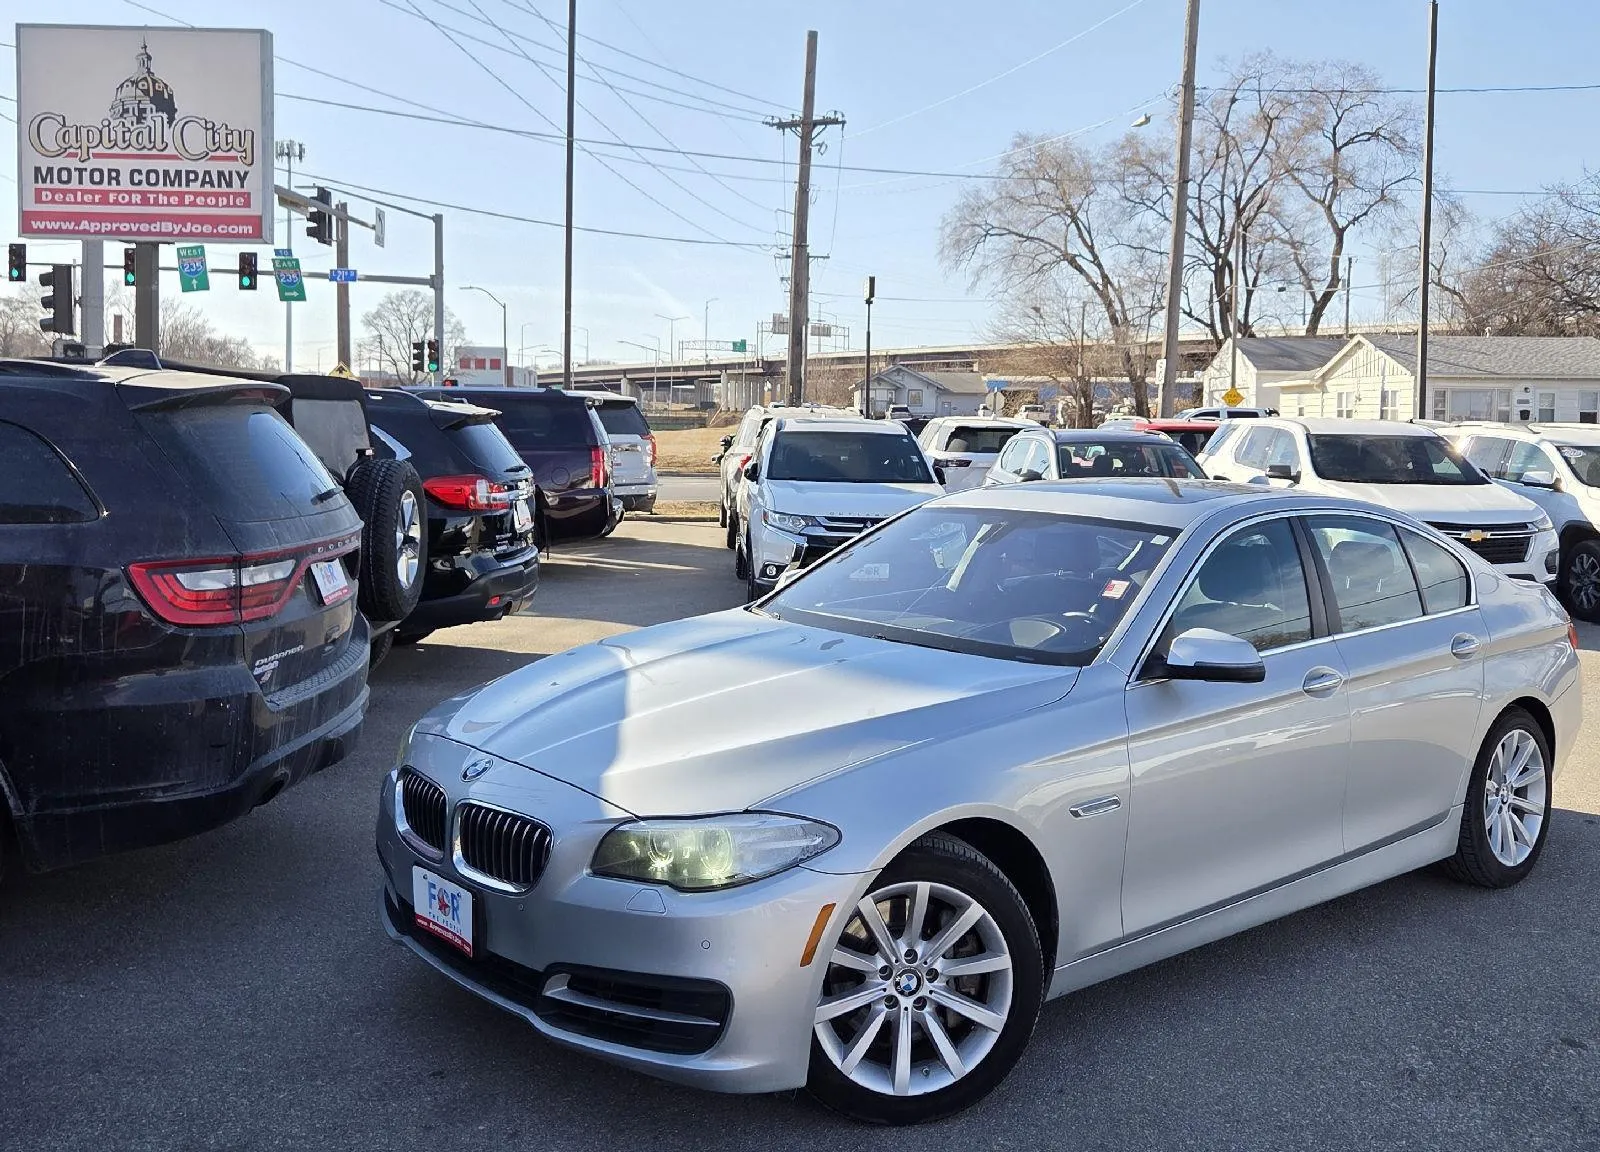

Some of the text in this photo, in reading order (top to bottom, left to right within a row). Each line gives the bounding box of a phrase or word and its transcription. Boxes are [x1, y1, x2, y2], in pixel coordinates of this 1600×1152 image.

[29, 112, 255, 167] Capital City
[33, 166, 250, 189] MOTOR COMPANY
[41, 190, 245, 207] Dealer FOR The People
[30, 219, 253, 235] www.ApprovedByJoe.com
[180, 248, 202, 257] WEST
[183, 262, 203, 272] 235
[275, 260, 297, 268] EAST
[280, 272, 298, 283] 235
[428, 881, 462, 925] FOR
